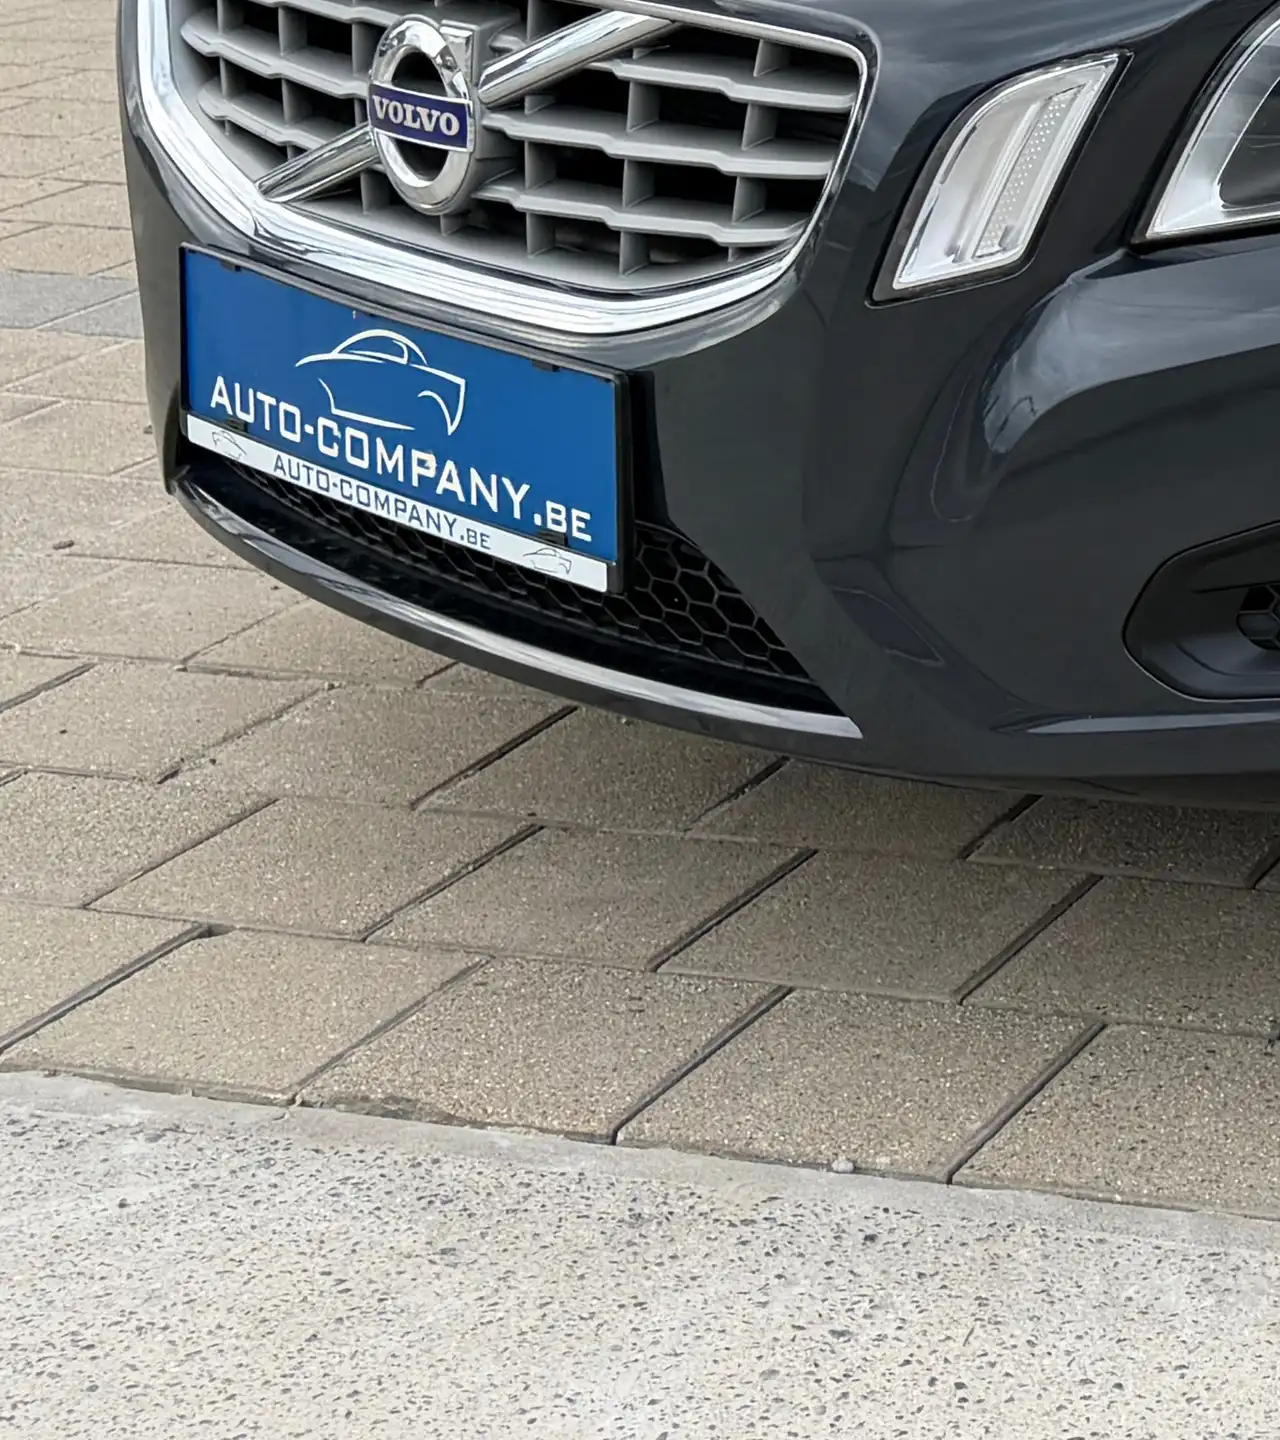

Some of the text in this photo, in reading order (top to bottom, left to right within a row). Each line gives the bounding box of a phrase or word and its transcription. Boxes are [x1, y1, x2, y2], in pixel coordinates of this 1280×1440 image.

[371, 94, 460, 136] VOLVO
[210, 375, 592, 542] AUTO-COMPANY.BE
[272, 454, 491, 550] AUTO-COMPANY.BE
